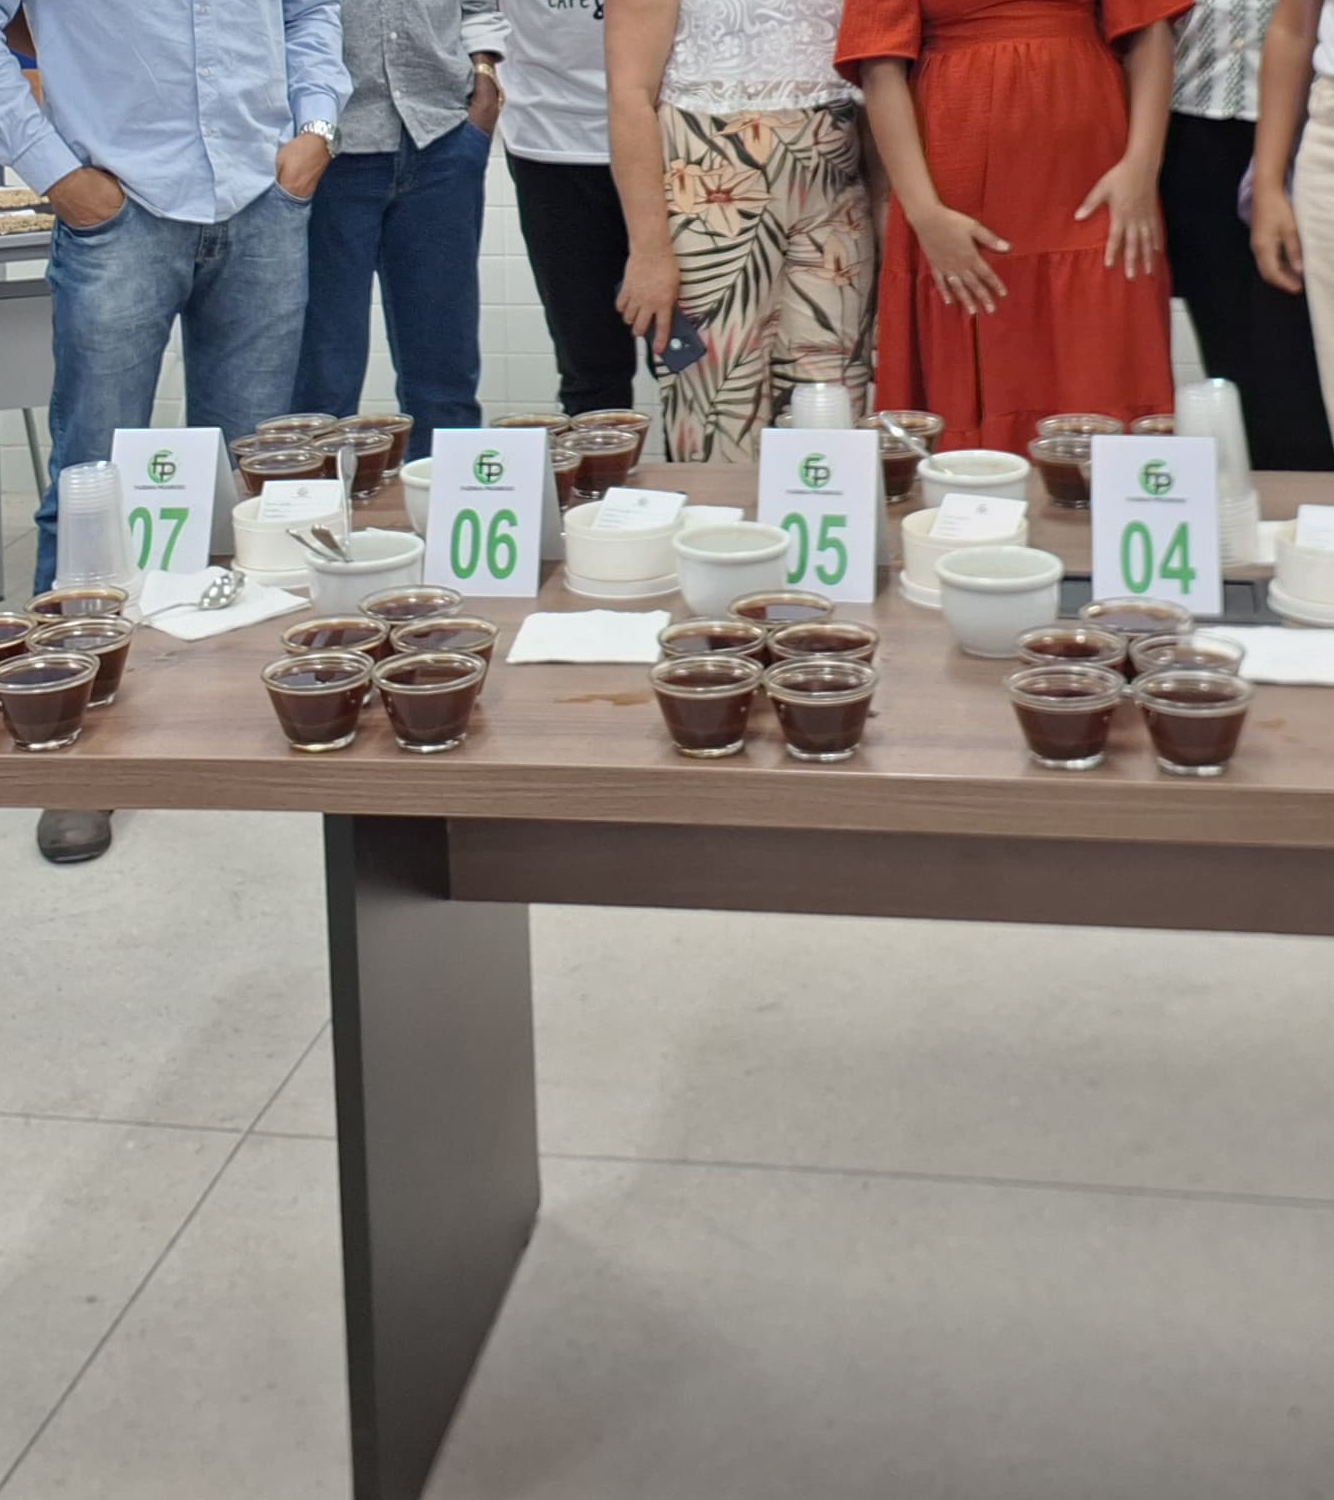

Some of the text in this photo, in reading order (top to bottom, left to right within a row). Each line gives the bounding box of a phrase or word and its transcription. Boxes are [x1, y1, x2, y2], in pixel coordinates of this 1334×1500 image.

[128, 506, 190, 572] 07
[450, 508, 519, 580] 06
[779, 511, 848, 586] 05
[1120, 519, 1197, 595] 04
